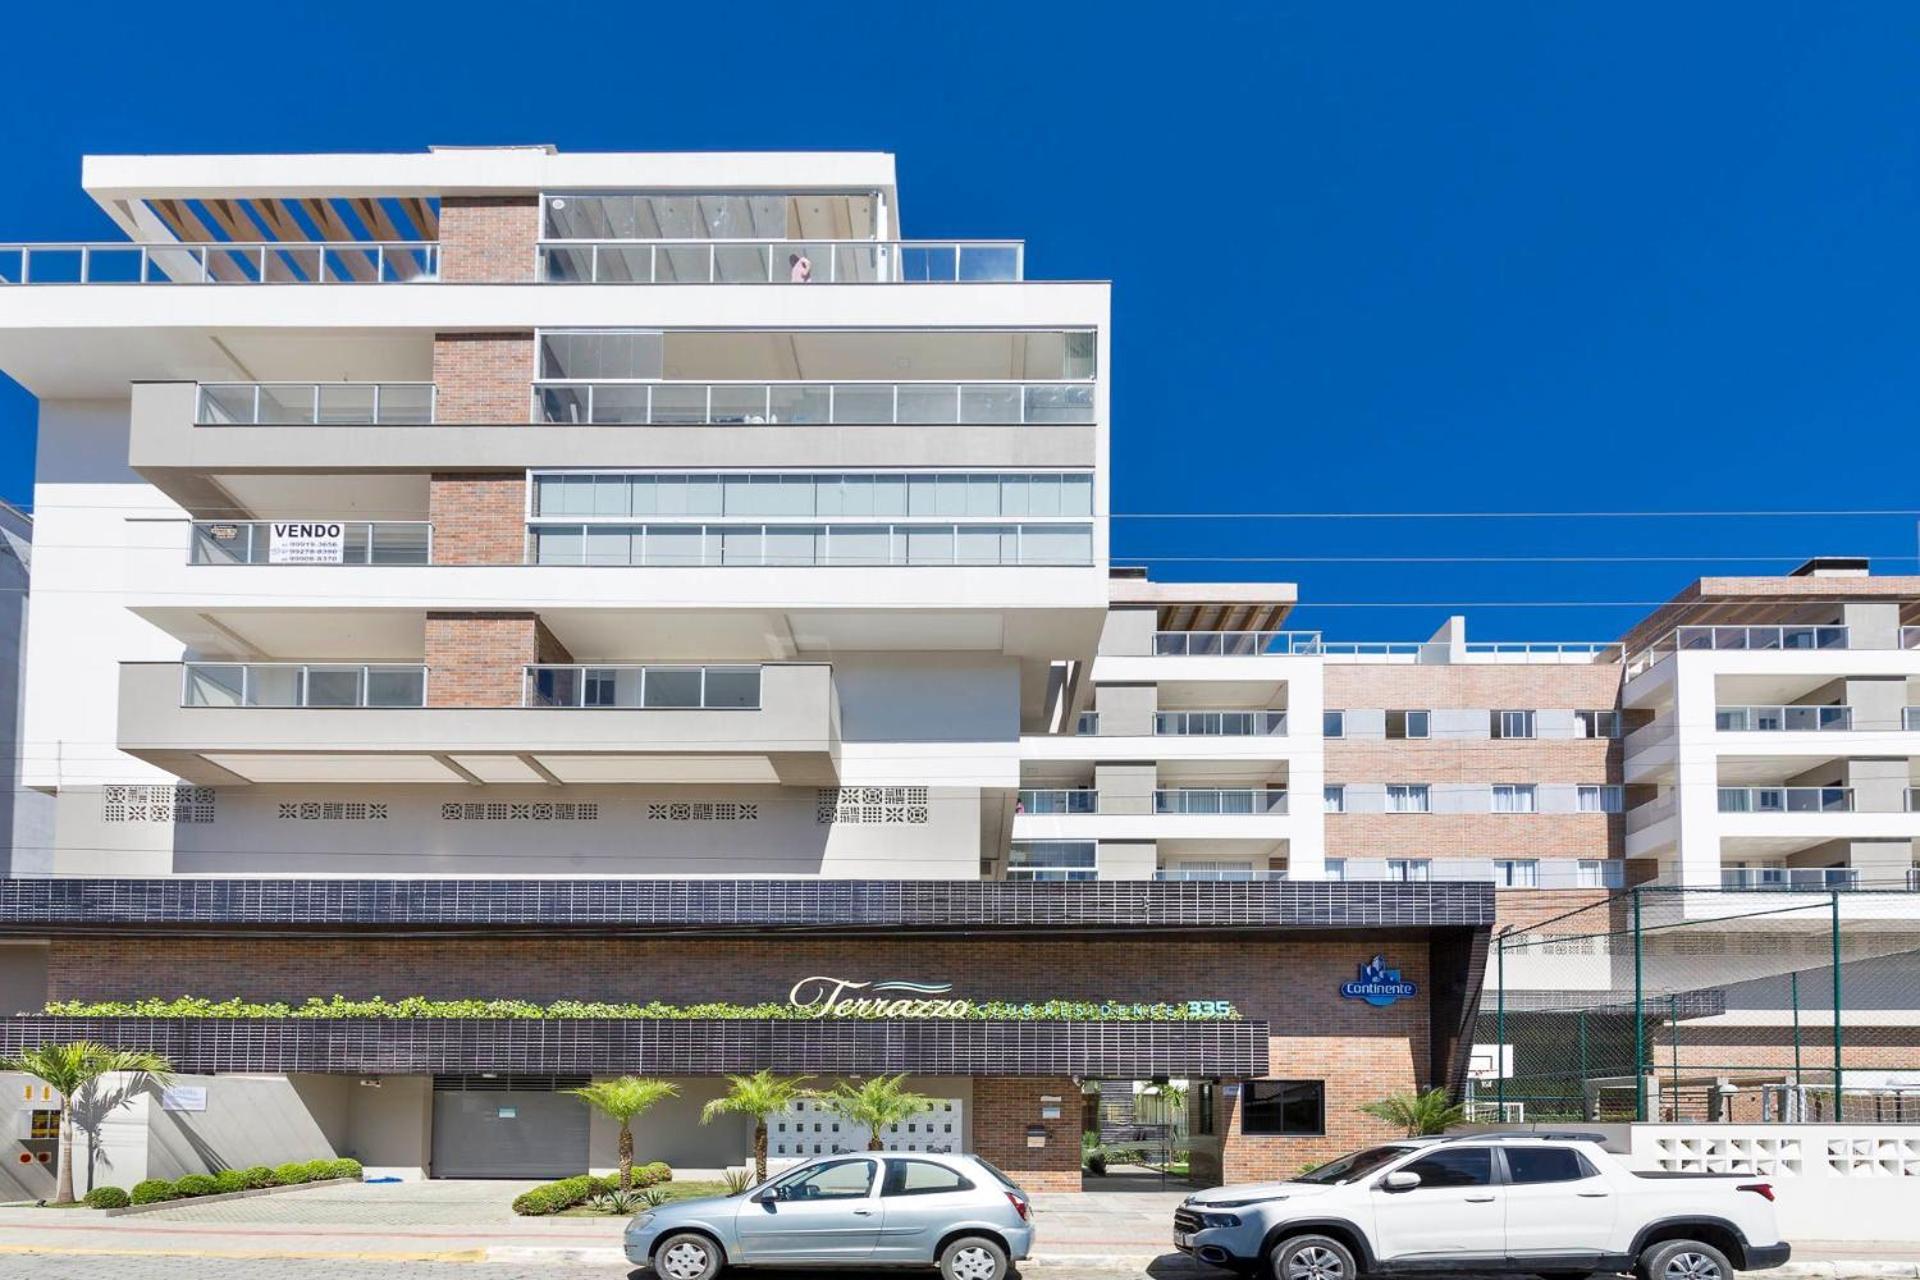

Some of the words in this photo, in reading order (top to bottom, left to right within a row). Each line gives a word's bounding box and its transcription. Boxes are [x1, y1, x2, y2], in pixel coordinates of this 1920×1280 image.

[274, 524, 340, 538] VENDO
[1347, 983, 1412, 995] Continente
[789, 976, 969, 1018] Terrazzo
[1187, 1000, 1230, 1016] 335
